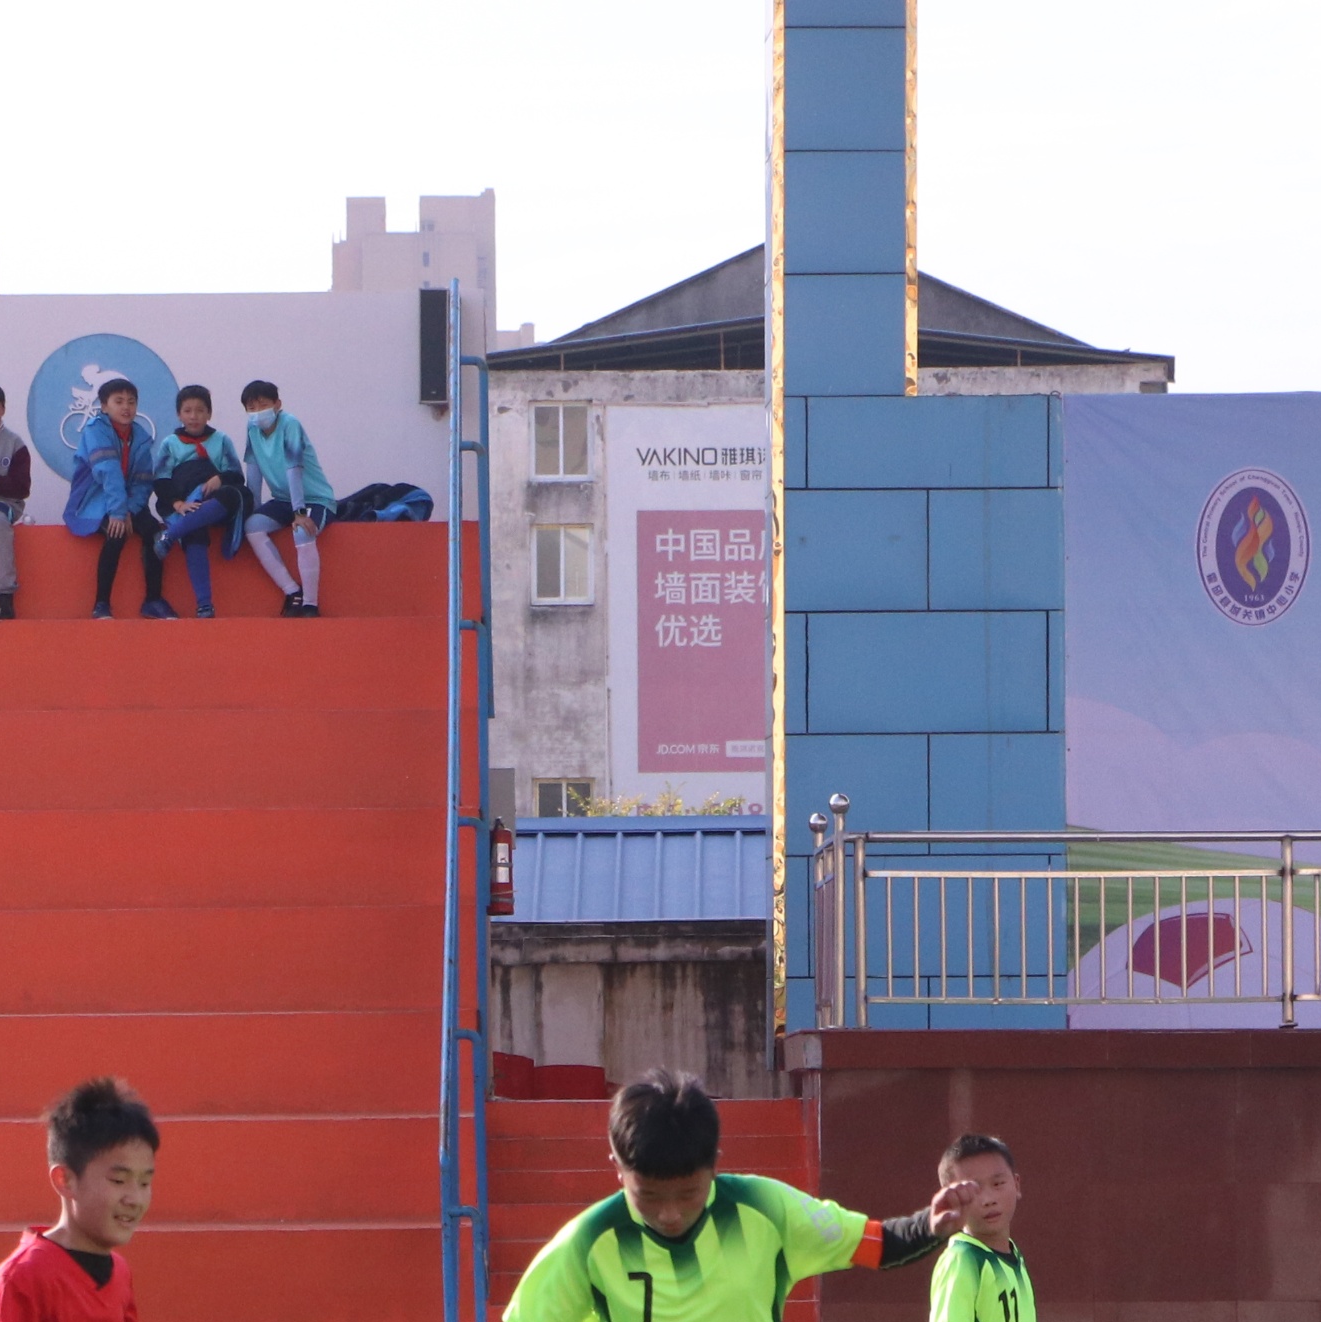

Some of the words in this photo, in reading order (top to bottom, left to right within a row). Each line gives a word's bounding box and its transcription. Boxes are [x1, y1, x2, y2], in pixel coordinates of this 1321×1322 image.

[636, 447, 718, 466] YAKINO
[655, 528, 766, 561] 中国品
[654, 570, 766, 605] 墙面装
[654, 614, 722, 648] 优选
[656, 744, 696, 755] JD.COM
